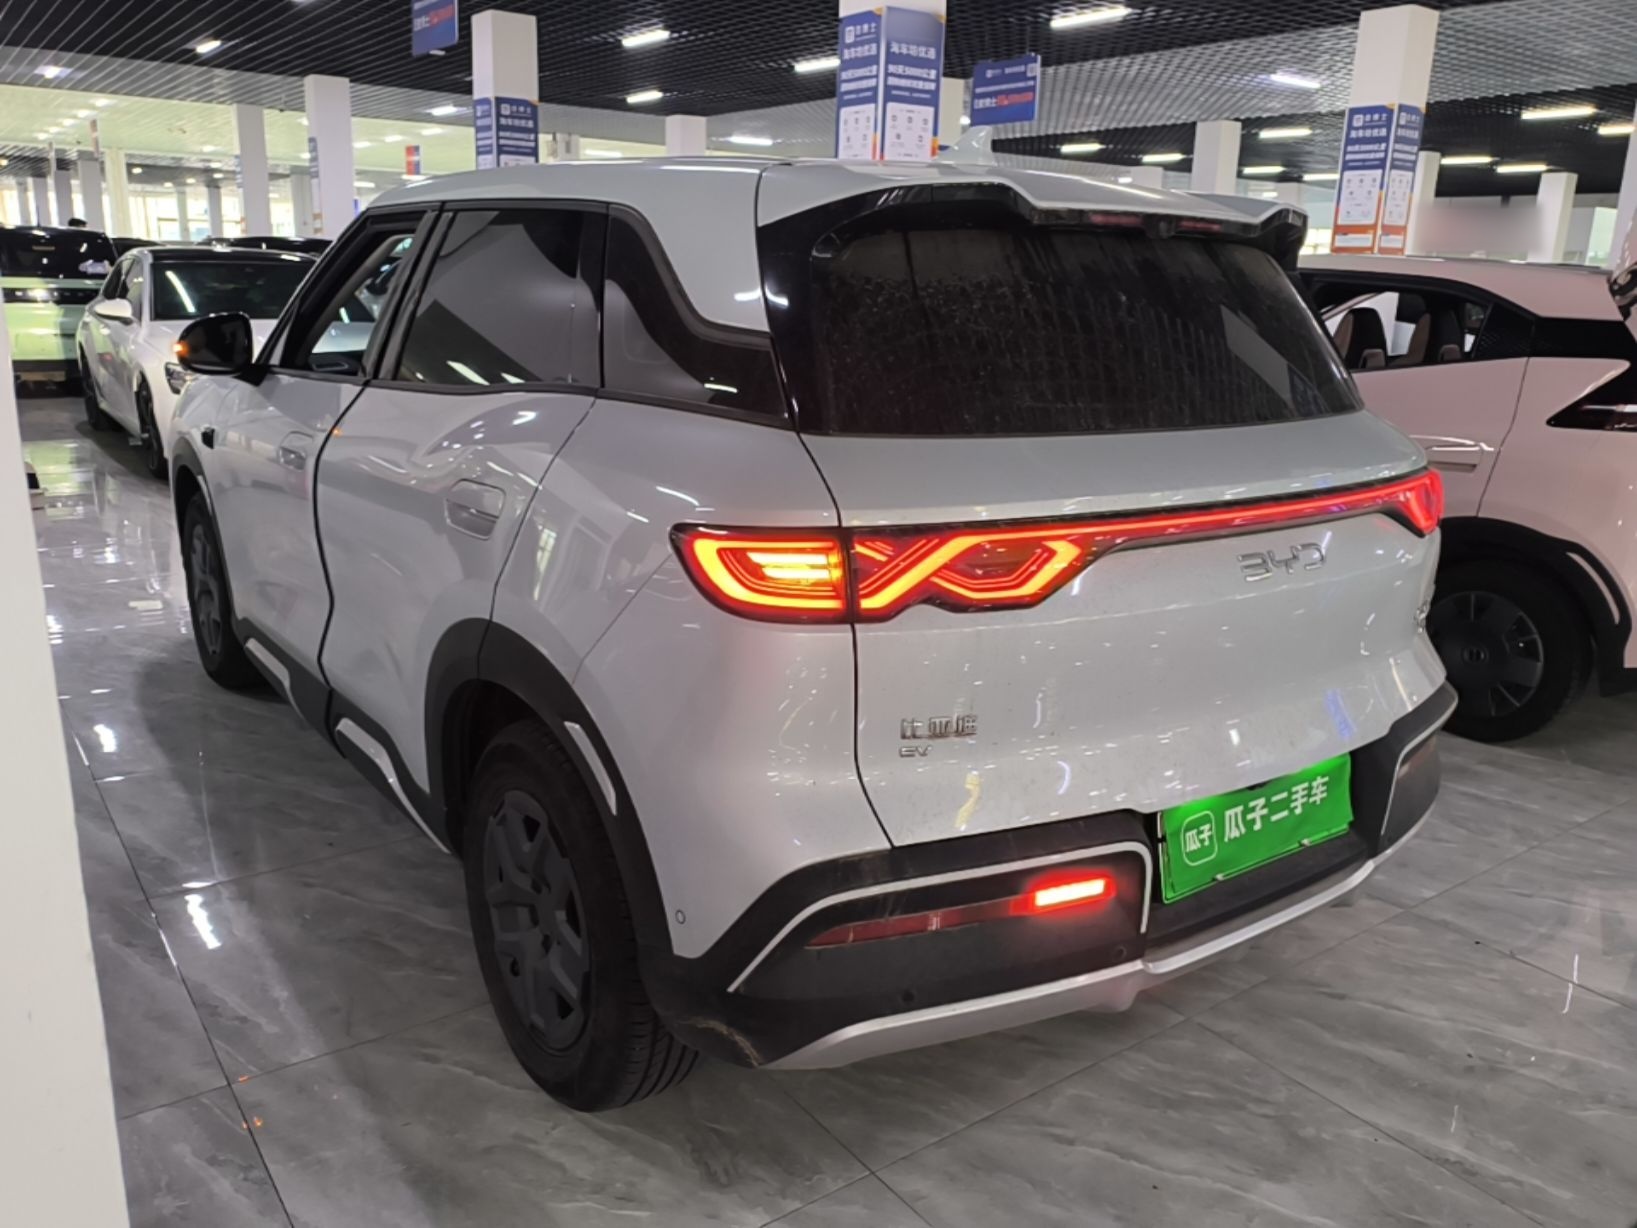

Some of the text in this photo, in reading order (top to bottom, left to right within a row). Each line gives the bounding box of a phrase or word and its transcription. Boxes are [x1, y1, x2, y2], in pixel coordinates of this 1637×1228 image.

[1238, 542, 1325, 582] BYD
[900, 715, 978, 740] 比亚迪
[899, 745, 932, 757] EV
[1223, 776, 1330, 843] 瓜子二手车
[1184, 823, 1213, 853] 瓜子
